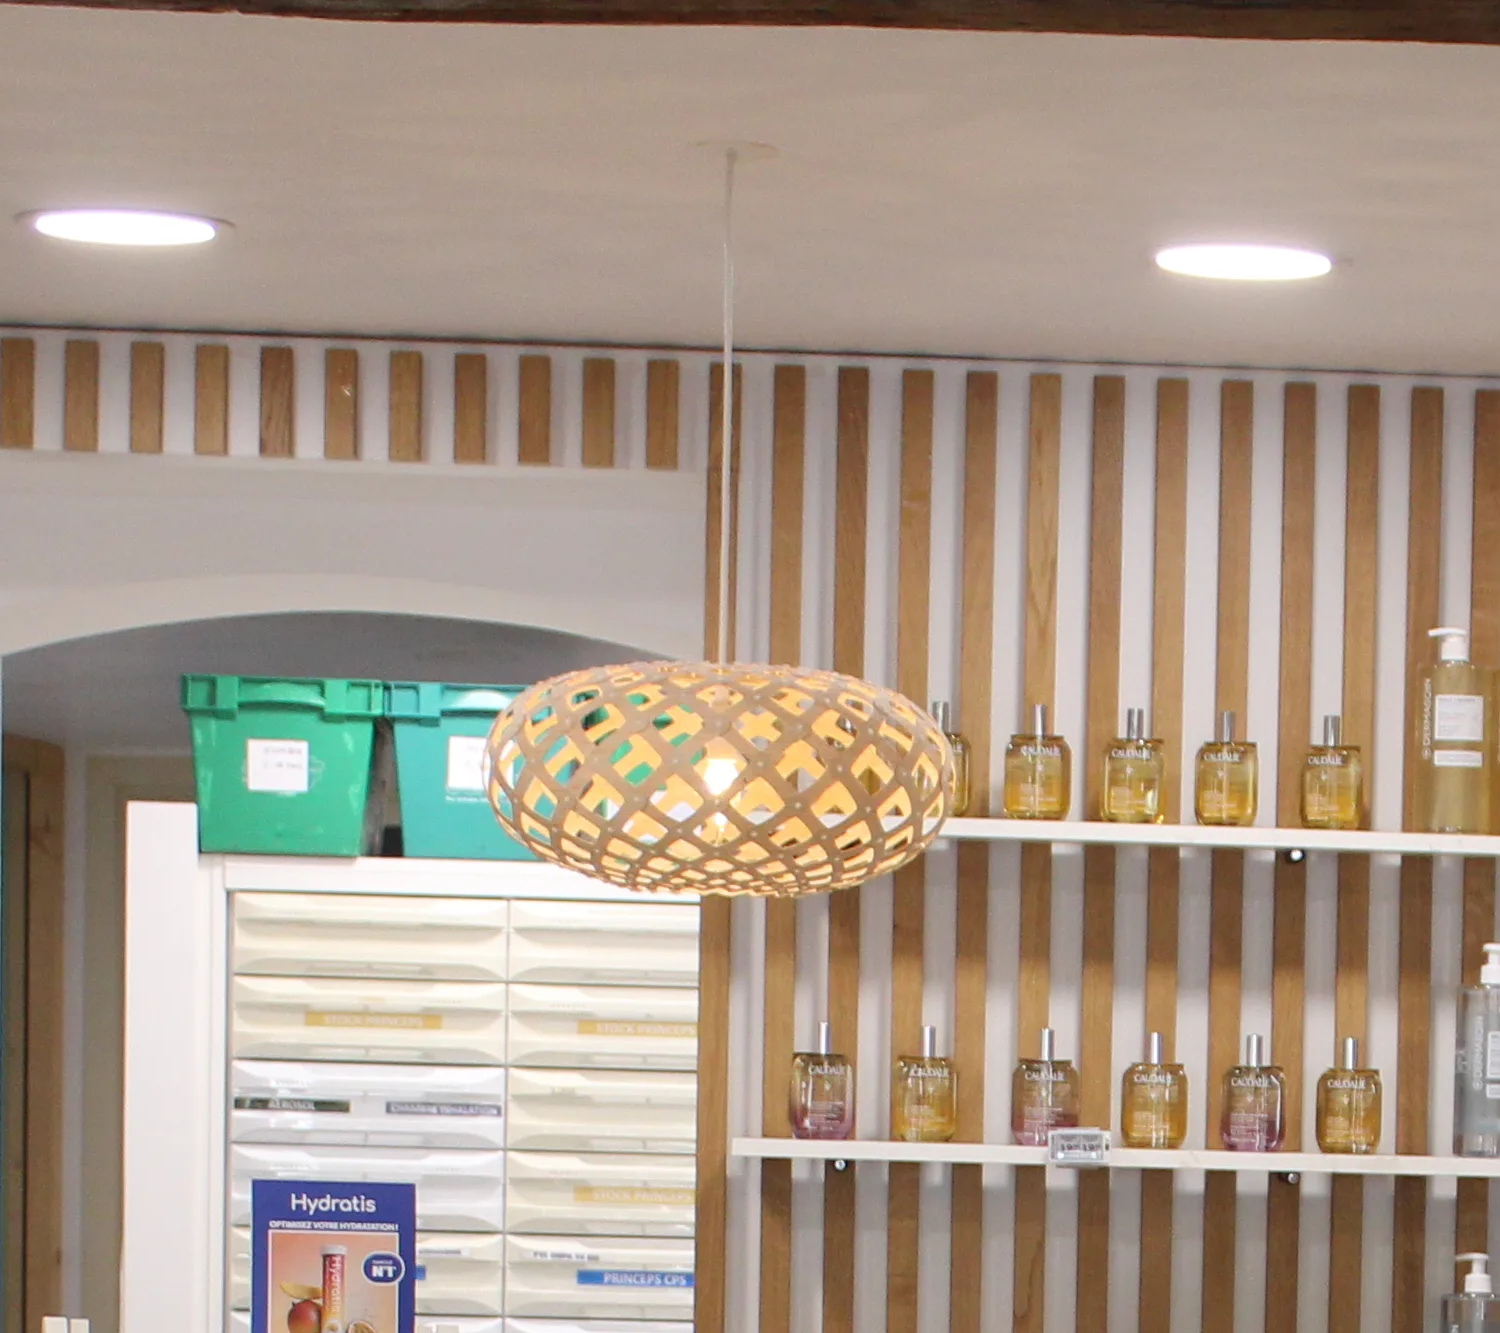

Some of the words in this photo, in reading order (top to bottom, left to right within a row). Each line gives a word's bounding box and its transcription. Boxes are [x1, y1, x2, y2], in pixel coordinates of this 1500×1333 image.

[290, 1193, 377, 1216] Hydratis
[604, 1273, 660, 1285] PRINCEPS
[665, 1273, 686, 1285] CPS
